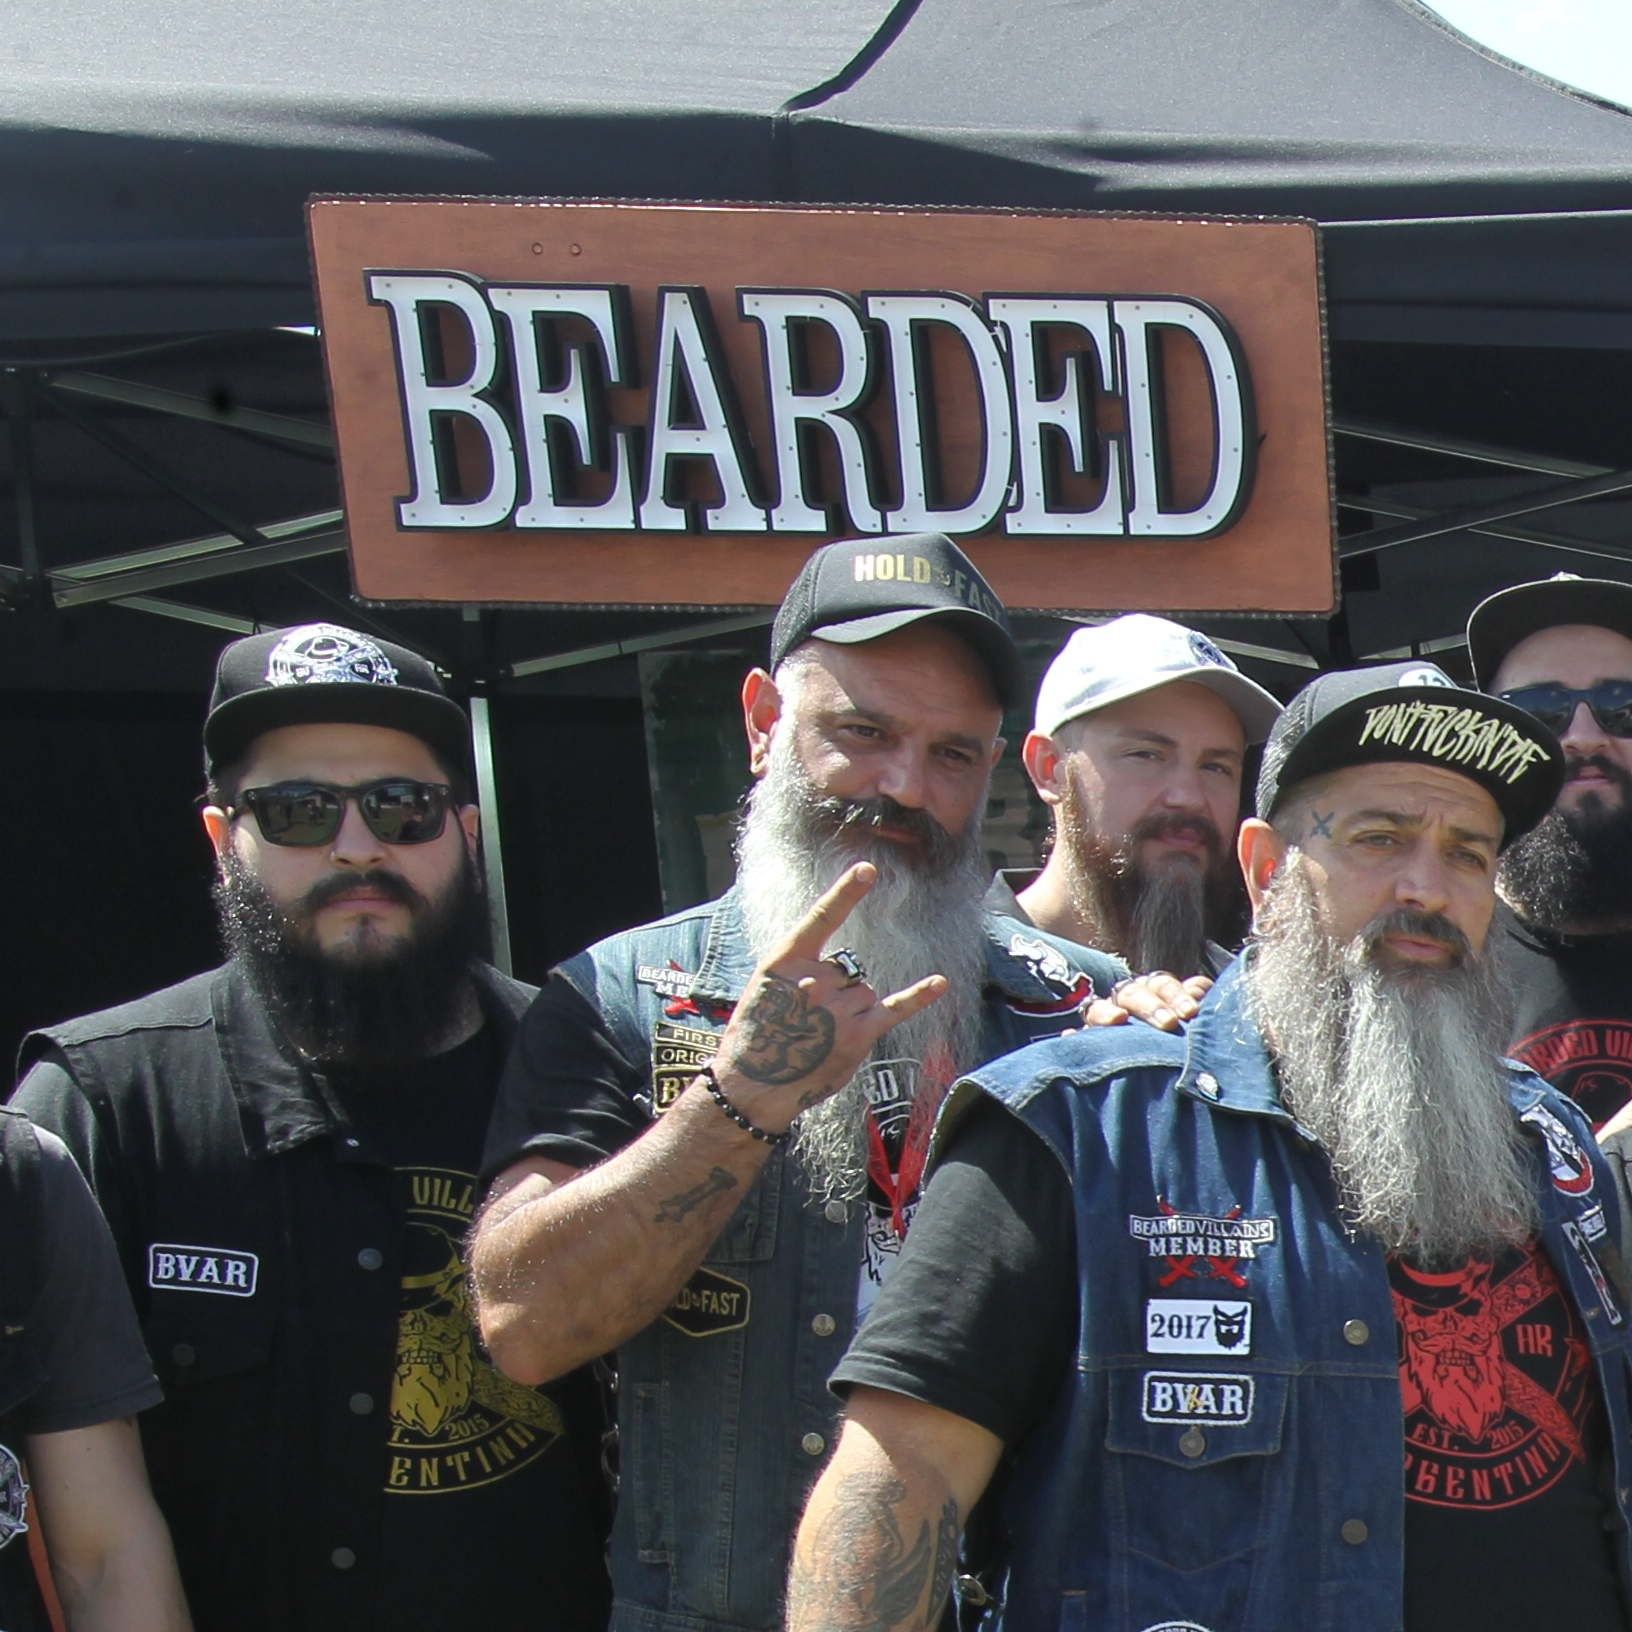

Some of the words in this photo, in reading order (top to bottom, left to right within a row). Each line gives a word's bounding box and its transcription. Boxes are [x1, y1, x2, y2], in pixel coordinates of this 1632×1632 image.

[362, 268, 1258, 540] BEARDED
[854, 554, 931, 584] HOLD
[672, 1029, 717, 1047] FIRS
[661, 1049, 710, 1066] ORIG
[1149, 1236, 1255, 1259] MEMBER
[155, 1252, 249, 1290] BVAR
[701, 1290, 741, 1316] FAST
[1150, 1313, 1212, 1340] 2017
[1516, 1323, 1553, 1358] AR
[1151, 1381, 1246, 1415] BVAR
[448, 1413, 490, 1441] 2015
[1413, 1422, 1459, 1451] EST.
